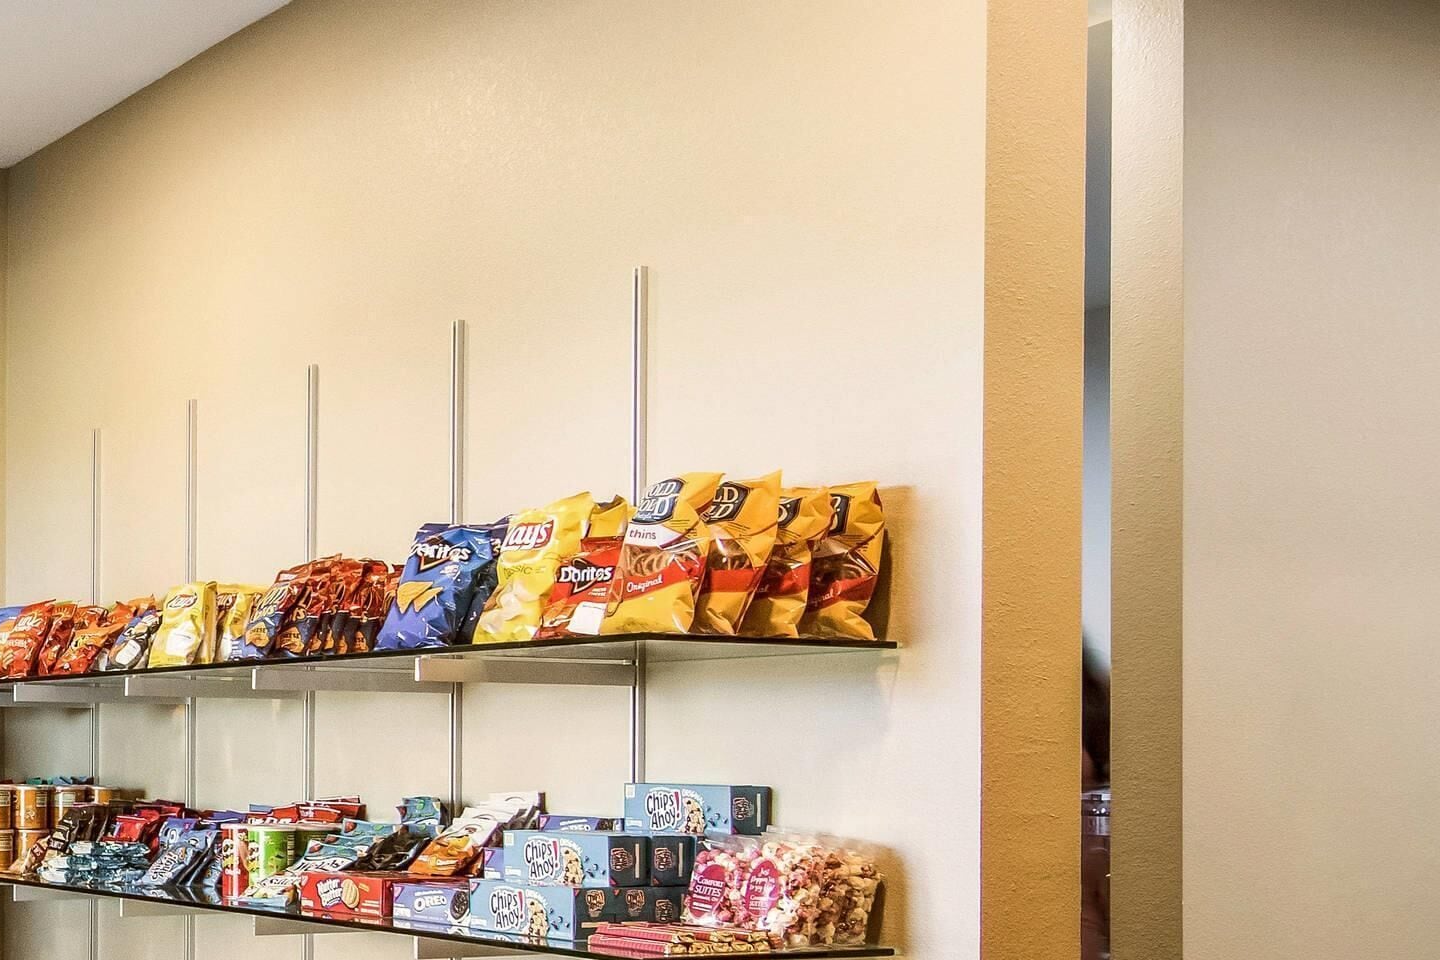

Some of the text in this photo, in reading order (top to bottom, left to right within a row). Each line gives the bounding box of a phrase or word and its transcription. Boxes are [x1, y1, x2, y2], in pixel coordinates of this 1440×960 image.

[648, 481, 677, 496] OLD
[639, 497, 670, 516] OLD
[629, 529, 657, 540] thins
[559, 566, 613, 583] Doritos
[626, 575, 663, 592] Original
[646, 790, 675, 816] Chips
[651, 803, 680, 829] Ahoy!
[525, 840, 553, 864] Chips
[530, 851, 559, 879] Ahoy!
[414, 895, 447, 912] OREO
[490, 890, 518, 914] Chips
[495, 901, 524, 929] Ahoy!
